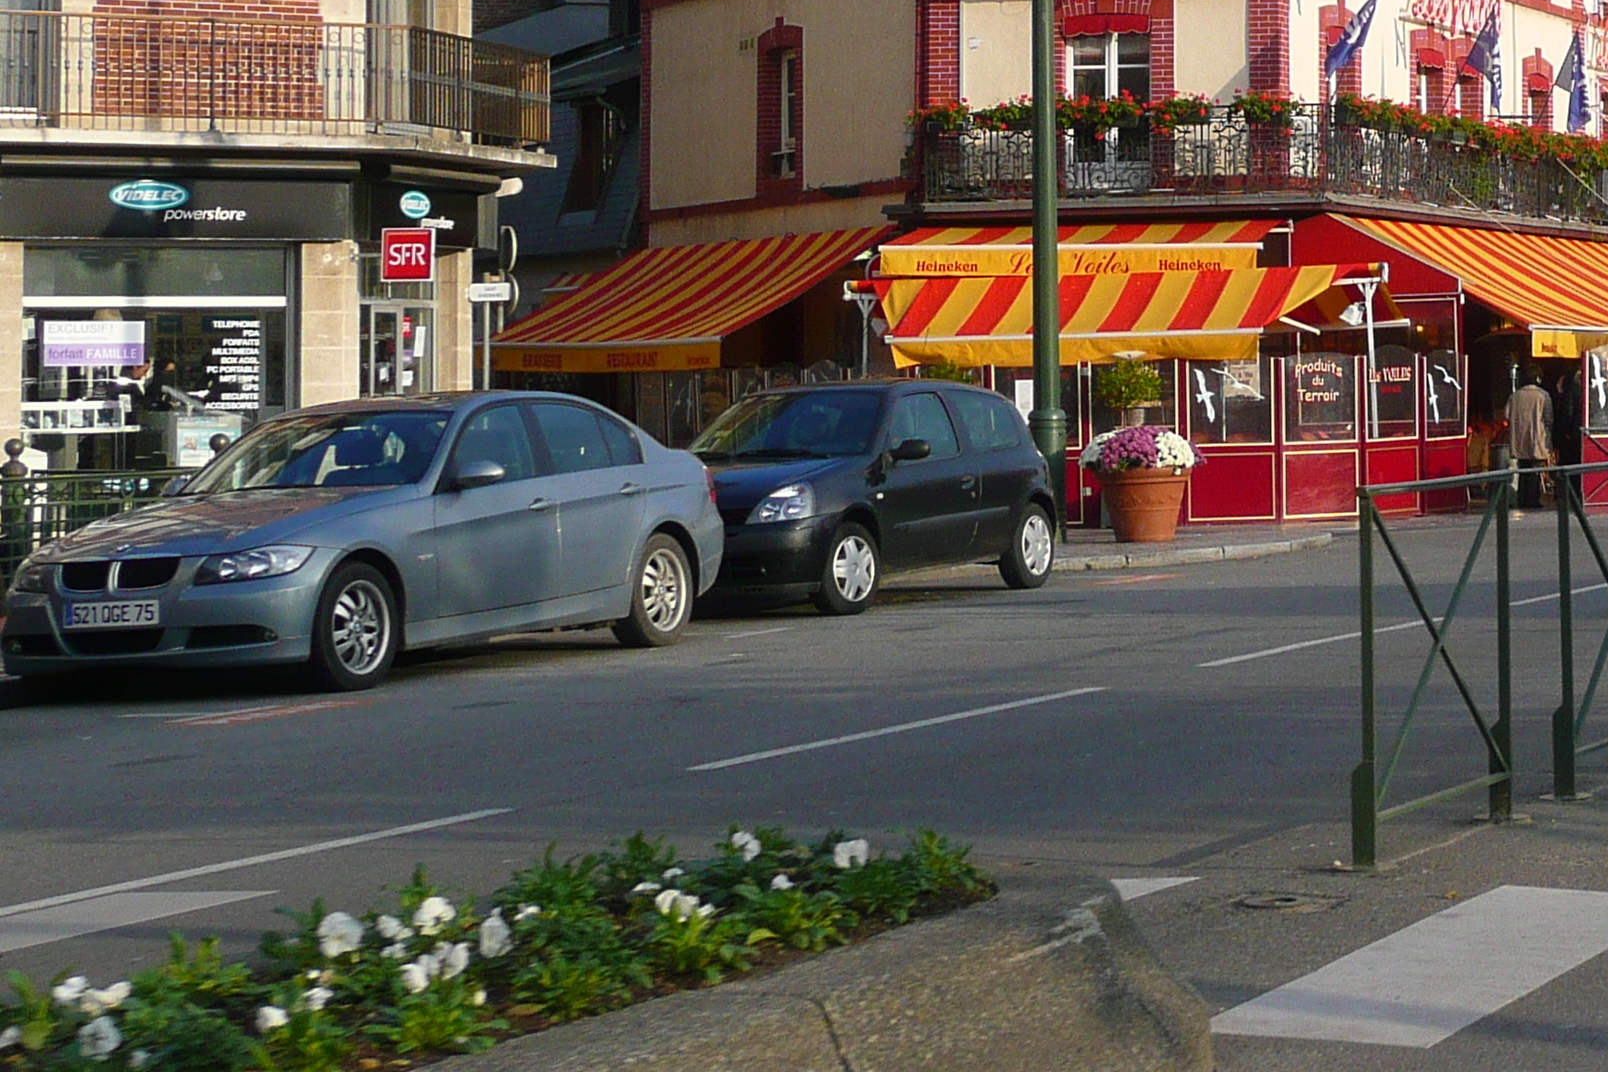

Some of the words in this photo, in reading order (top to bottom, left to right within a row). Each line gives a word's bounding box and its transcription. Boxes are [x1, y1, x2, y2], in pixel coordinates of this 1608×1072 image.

[164, 207, 247, 222] powerstore
[388, 243, 426, 266] SFR
[916, 260, 978, 272] Heineken
[1071, 252, 1130, 275] Voiles
[1158, 259, 1222, 272] Heineken
[48, 348, 84, 360] forfait
[86, 348, 138, 359] FAMILLE
[1295, 358, 1343, 378] Produits
[1312, 375, 1325, 387] du
[1297, 388, 1340, 403] Terroir
[73, 606, 98, 625] 521
[133, 603, 155, 622] 75
